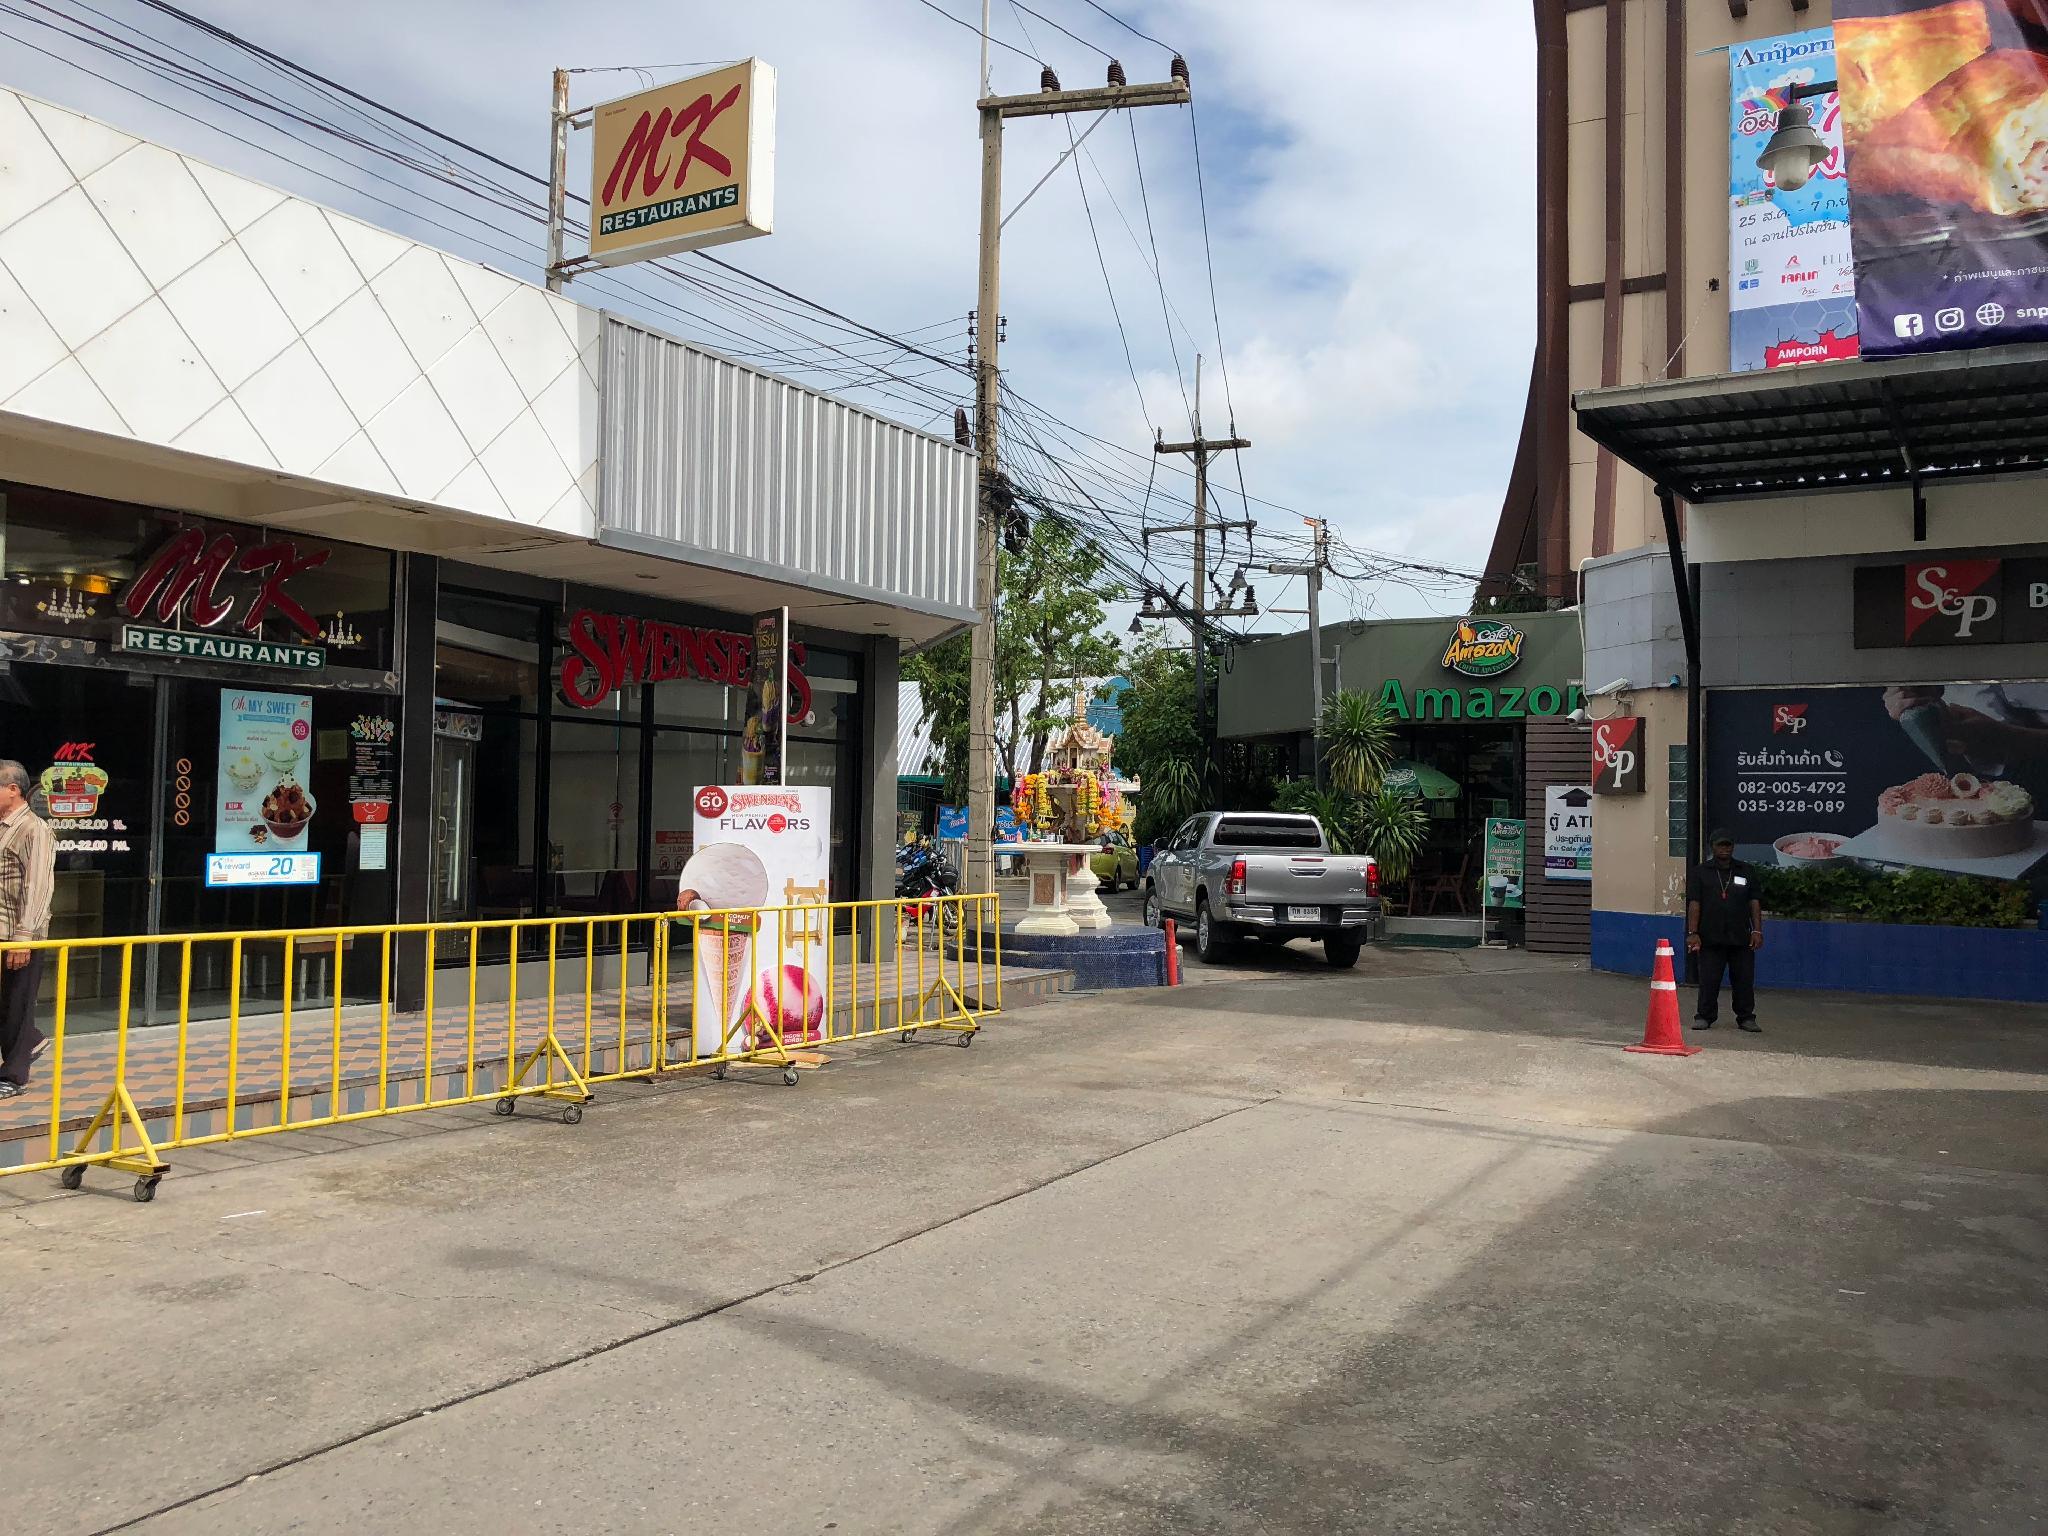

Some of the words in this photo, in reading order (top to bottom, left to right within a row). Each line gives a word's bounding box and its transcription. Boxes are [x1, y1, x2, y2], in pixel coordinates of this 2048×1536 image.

[602, 83, 742, 207] MK
[602, 187, 736, 233] RESTAURANTS
[1739, 214, 1756, 228] 25
[1778, 345, 1828, 359] AMPORN
[126, 526, 332, 641] MK
[128, 630, 321, 667] RESTAURANTS
[561, 609, 812, 725] SWENSES
[249, 700, 263, 712] MY
[267, 701, 297, 715] SWEET
[1737, 746, 1821, 766] รับสั่งทำเค้ก
[1738, 781, 1846, 794] 082-005-4792
[1738, 800, 1845, 813] 035-328-089
[1566, 814, 1592, 828] AT
